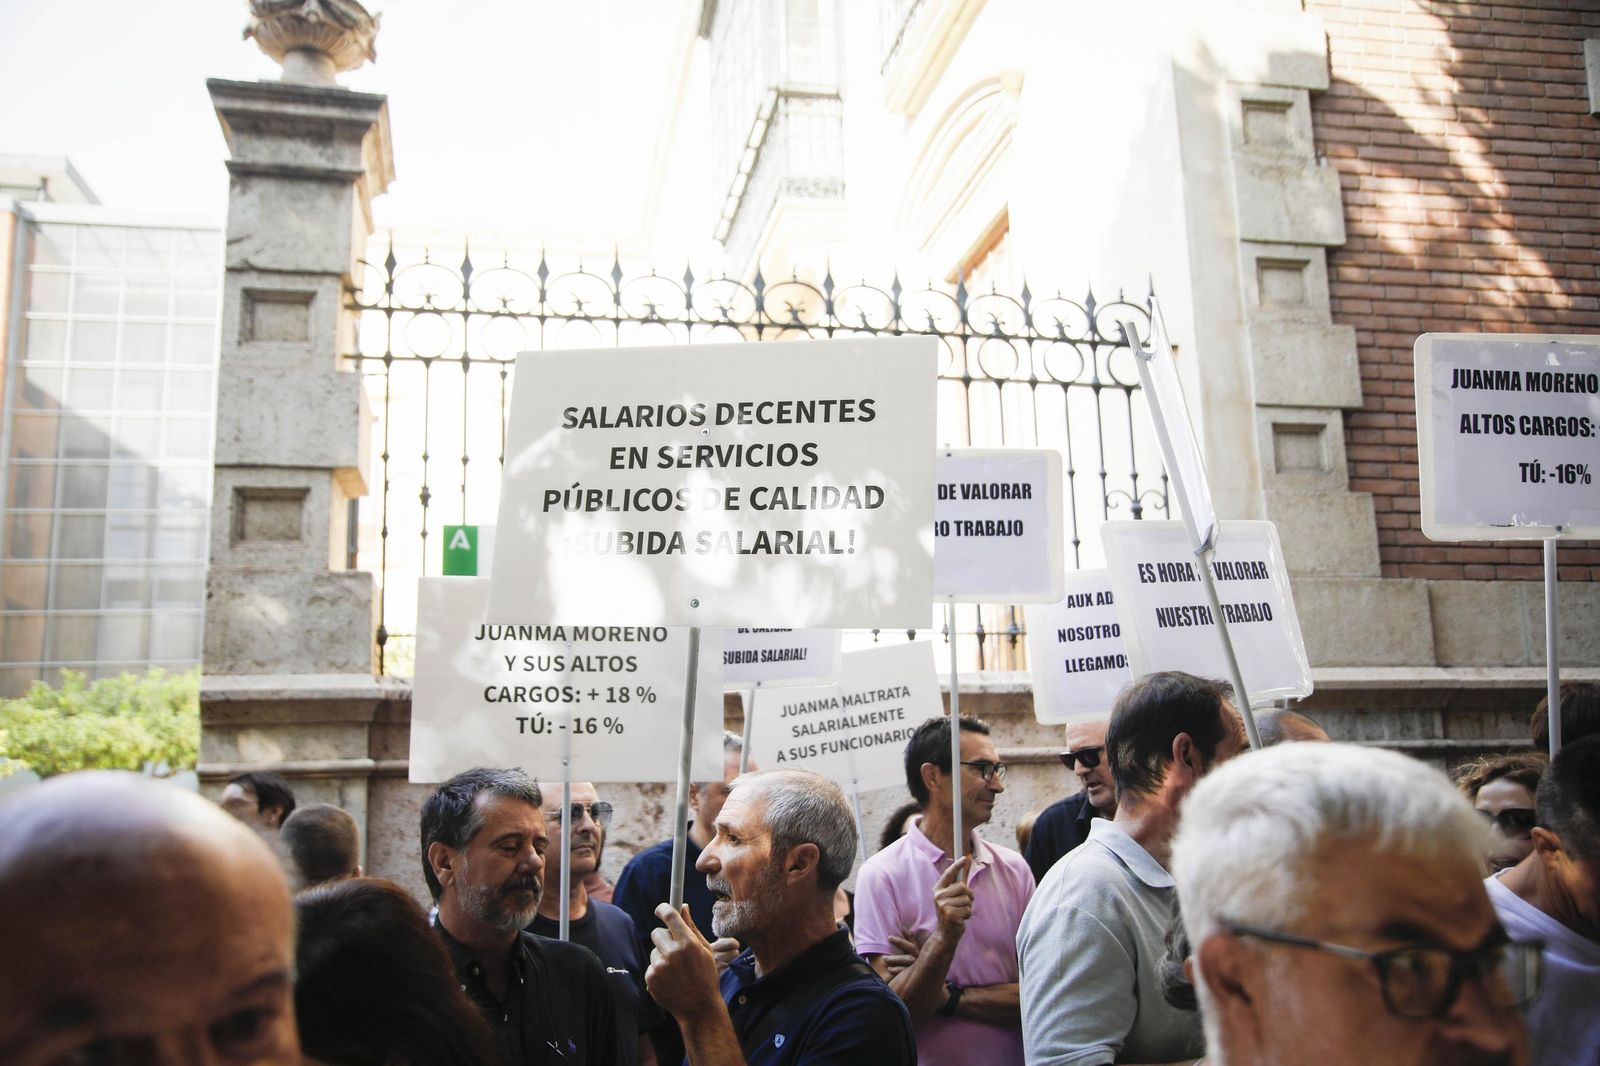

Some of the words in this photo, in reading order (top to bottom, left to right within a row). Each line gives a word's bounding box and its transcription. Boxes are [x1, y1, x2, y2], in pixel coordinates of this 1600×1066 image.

[1451, 368, 1522, 391] JUANMA
[1525, 372, 1599, 394] MORENO
[561, 401, 707, 430] SALARIOS
[715, 398, 877, 426] DECENTES
[1459, 413, 1516, 435] ALTOS
[1519, 415, 1595, 438] CARGOS:
[609, 446, 648, 470] EN
[657, 442, 819, 469] SERVICIOS
[1518, 459, 1546, 483] TÚ:
[1549, 463, 1592, 485] -16%
[542, 481, 691, 513] PÚBLICOS
[749, 484, 885, 511] CALIDAD
[937, 483, 957, 500] DE
[960, 482, 1032, 500] VALORAR
[448, 528, 471, 550] A
[953, 519, 1024, 537] TRABAJO
[696, 528, 856, 555] SALARIAL!
[1137, 562, 1156, 584] ES
[1157, 562, 1196, 583] HORA
[1212, 560, 1270, 581] VALORAR
[1067, 592, 1094, 609] AUX
[474, 624, 567, 642] JUANMA
[572, 626, 668, 642] MORENO
[1057, 623, 1121, 643] NOSOTRO
[504, 655, 517, 671] Y
[523, 655, 565, 672] SUS
[570, 655, 638, 672] ALTOS
[761, 647, 807, 663] SALARIAL!
[483, 686, 581, 703] CARGOS:
[780, 698, 839, 718] JUANMA
[842, 685, 911, 707] MALTRATA
[515, 712, 552, 734] TÚ:
[791, 708, 905, 738] SALARIALMENTE
[776, 750, 787, 764] A
[789, 745, 817, 761] SUS
[821, 727, 915, 755] FUNCIONARIO
